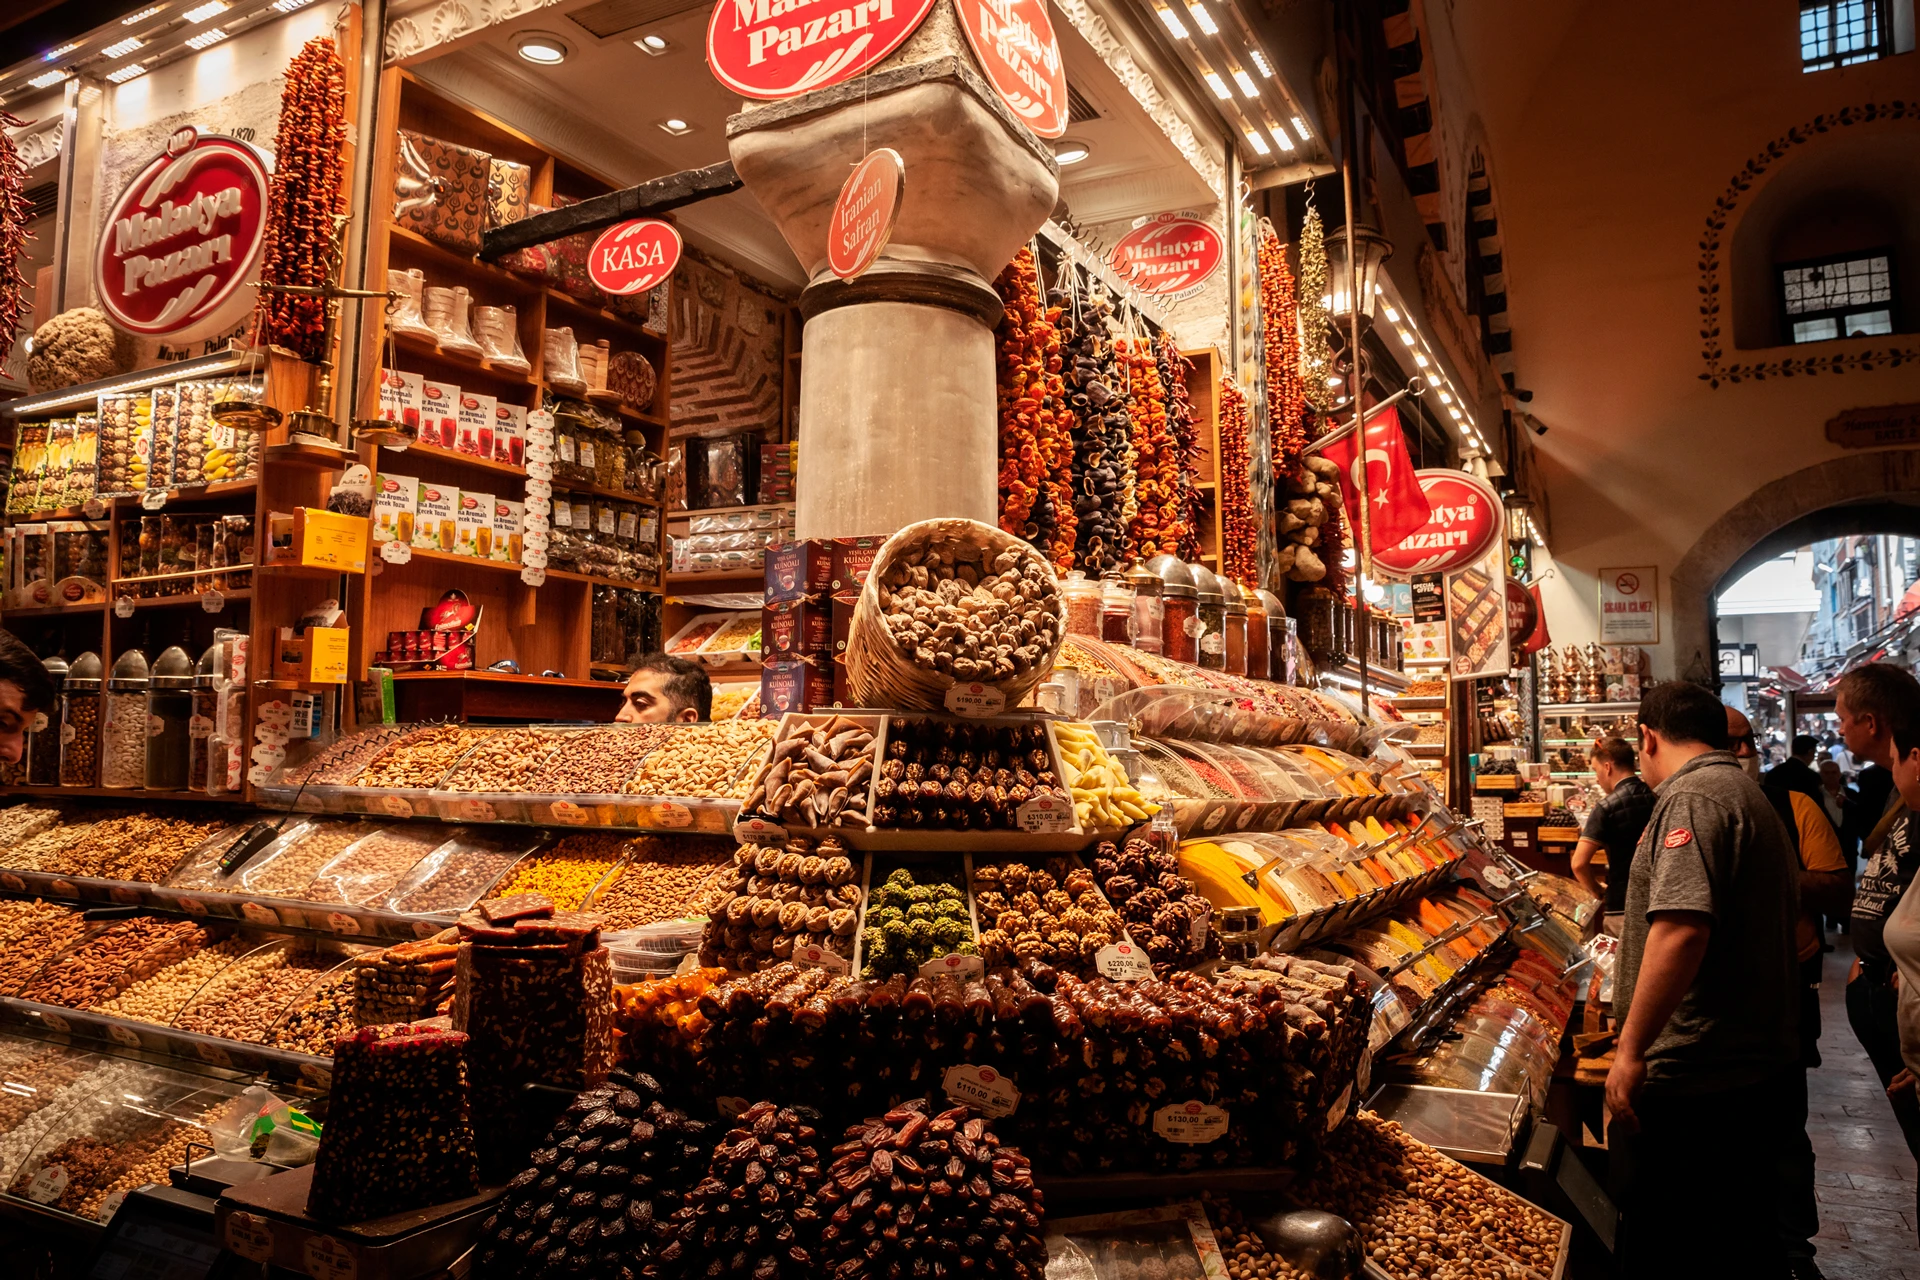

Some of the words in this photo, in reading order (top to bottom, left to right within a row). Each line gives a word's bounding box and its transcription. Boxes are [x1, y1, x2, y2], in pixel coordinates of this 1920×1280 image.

[747, 0, 894, 68] Pazarı
[978, 2, 1053, 109] Pazarı
[230, 127, 256, 142] 1870
[113, 186, 243, 257] Malatya
[1181, 211, 1199, 220] 1870
[842, 208, 881, 257] Safran
[600, 239, 666, 274] KASA
[1124, 239, 1206, 261] Malatya
[121, 233, 233, 297] Pazarı
[1130, 258, 1201, 279] Pazarı
[1428, 503, 1475, 528] atya
[1390, 530, 1469, 552] azarı
[774, 559, 800, 570] KUİNOALI
[843, 555, 875, 564] KUİNOA
[1412, 582, 1436, 590] SPECIAL
[956, 696, 982, 705] ₺190,00
[1878, 881, 1901, 895] USA
[1108, 960, 1134, 968] ₺220,00
[956, 1081, 988, 1099] ₺110,00
[1168, 1115, 1199, 1124] ₺130,00
